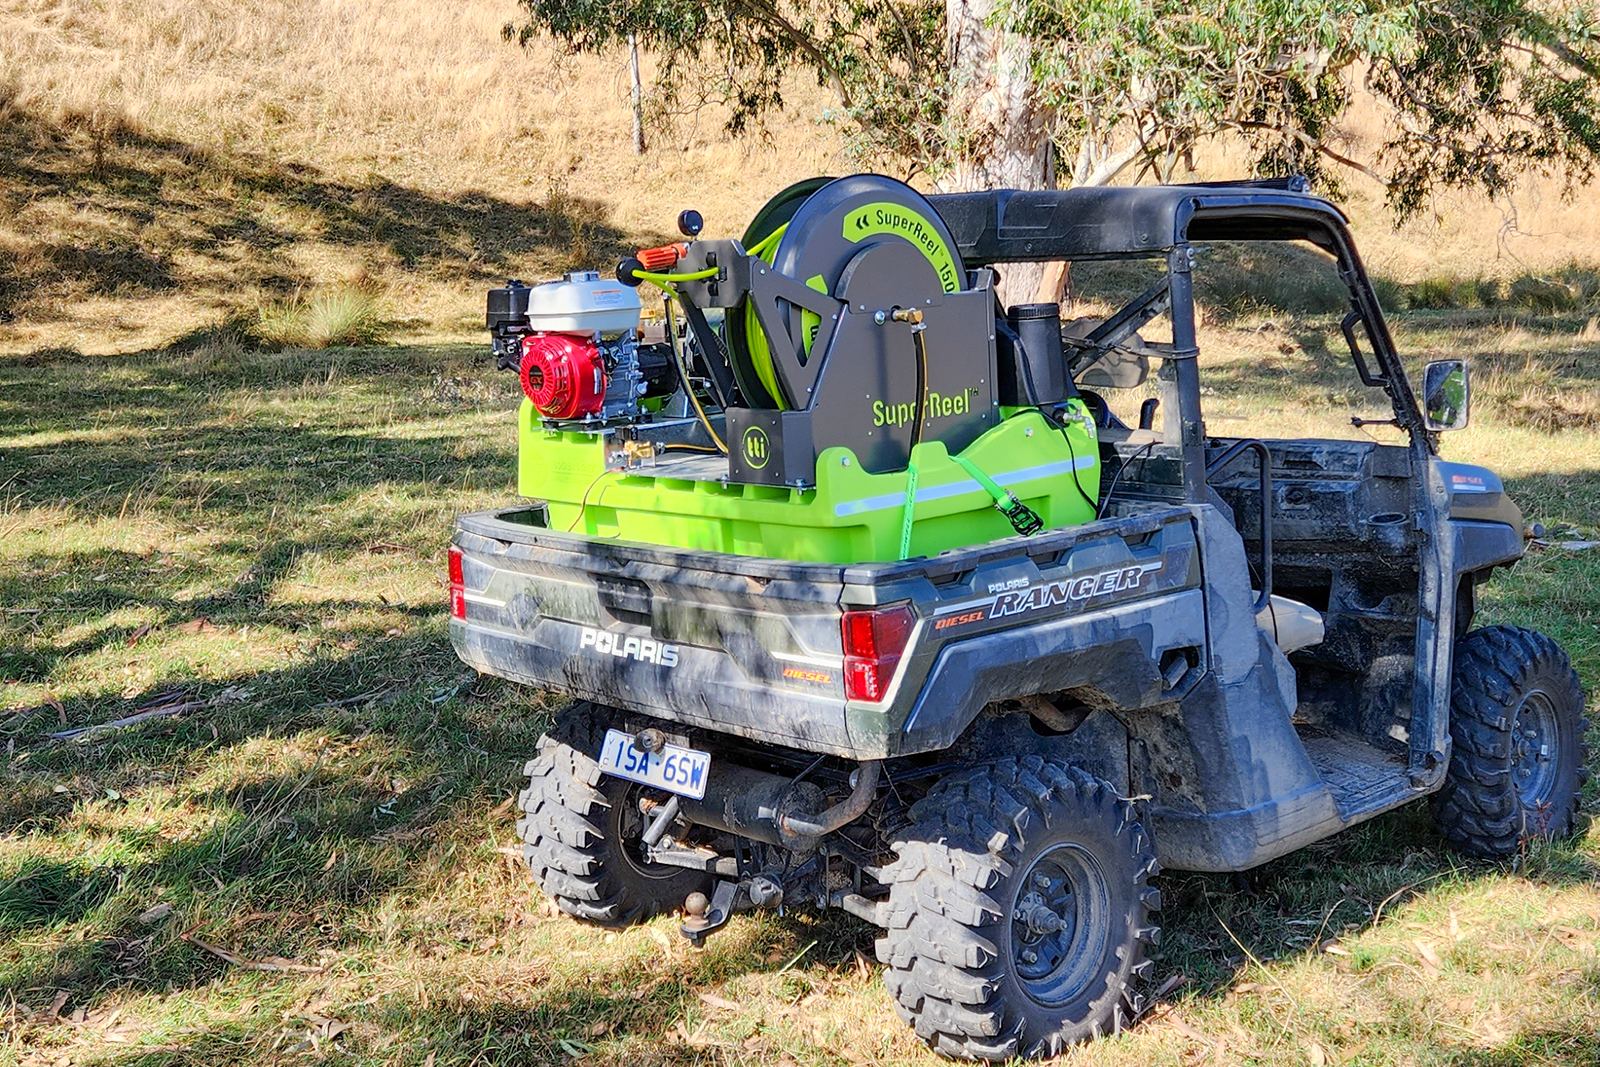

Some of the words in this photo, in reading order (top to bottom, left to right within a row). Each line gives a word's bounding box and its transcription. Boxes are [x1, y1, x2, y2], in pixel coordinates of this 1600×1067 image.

[938, 261, 956, 293] 150
[988, 576, 1030, 594] POLARIS
[989, 565, 1143, 620] RANGER
[935, 611, 985, 631] DIESEL
[580, 628, 679, 668] POLARIS
[782, 668, 832, 684] DIESEL
